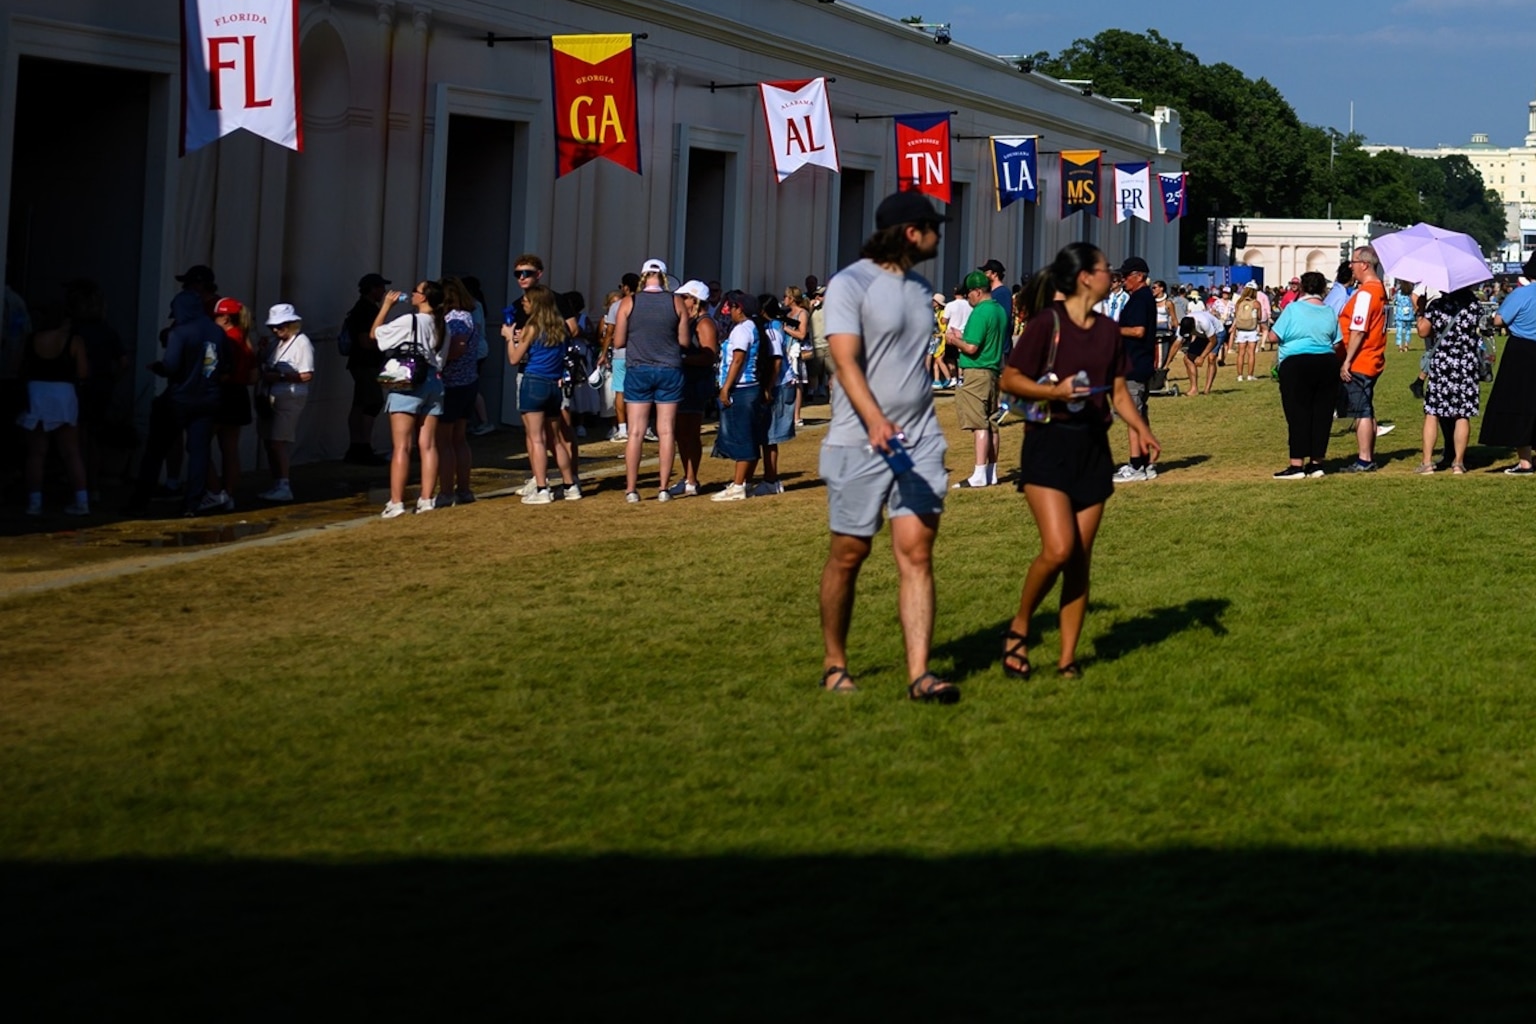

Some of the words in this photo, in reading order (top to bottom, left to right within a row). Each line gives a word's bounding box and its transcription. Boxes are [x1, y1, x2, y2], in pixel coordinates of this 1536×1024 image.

[214, 13, 268, 27] FLORIDA
[207, 35, 273, 111] FL
[575, 74, 615, 85] GEORGIA
[781, 99, 815, 110] ALABAMA
[569, 94, 627, 145] GA
[786, 114, 826, 156] AL
[904, 150, 944, 186] TN
[1002, 159, 1035, 192] LA
[1067, 179, 1096, 205] MS
[1121, 187, 1145, 210] PR
